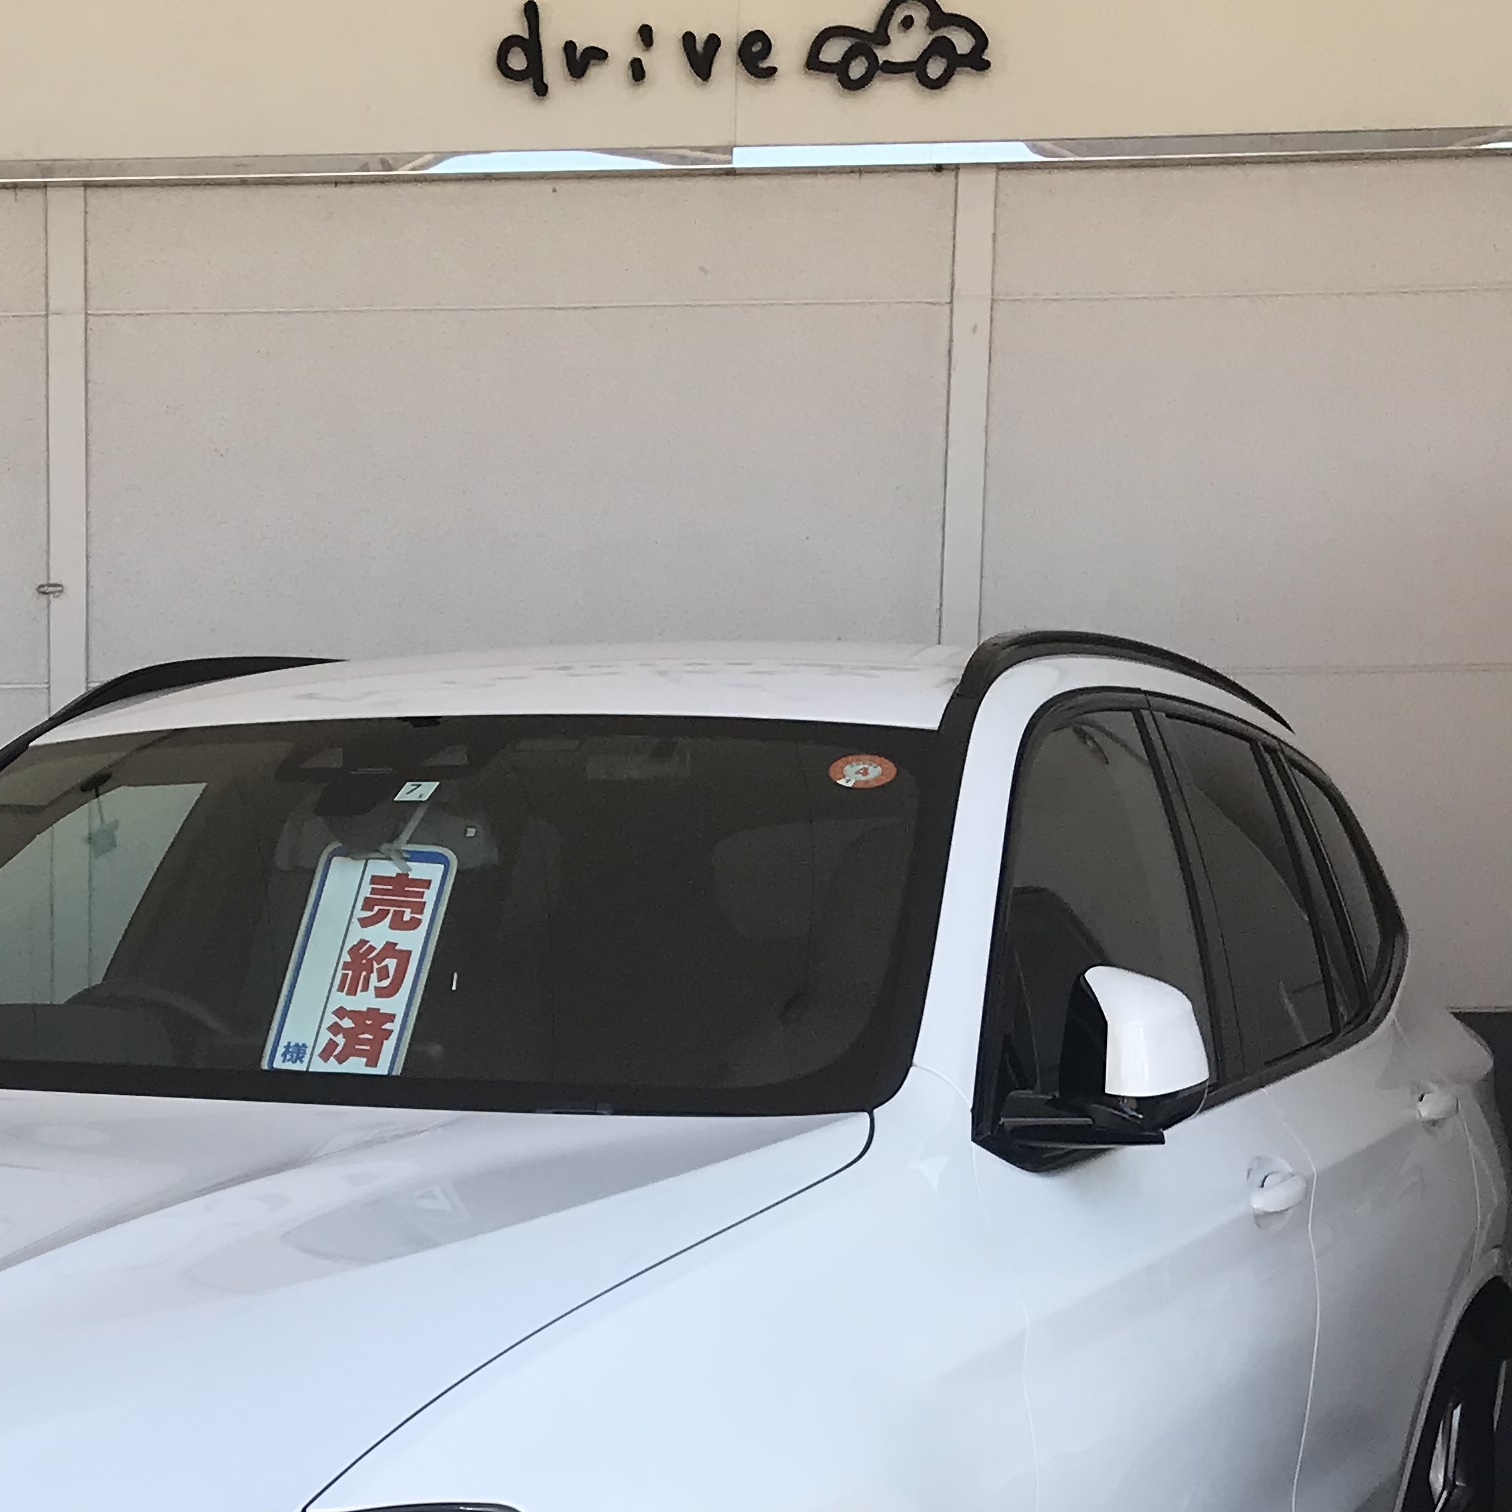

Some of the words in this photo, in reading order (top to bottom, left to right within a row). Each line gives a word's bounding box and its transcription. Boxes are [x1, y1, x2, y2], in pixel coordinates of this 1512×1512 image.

[496, 0, 778, 98] drive
[855, 766, 870, 777] 4
[406, 784, 422, 795] 7
[317, 872, 433, 1068] 売約済
[280, 1041, 309, 1065] 様
